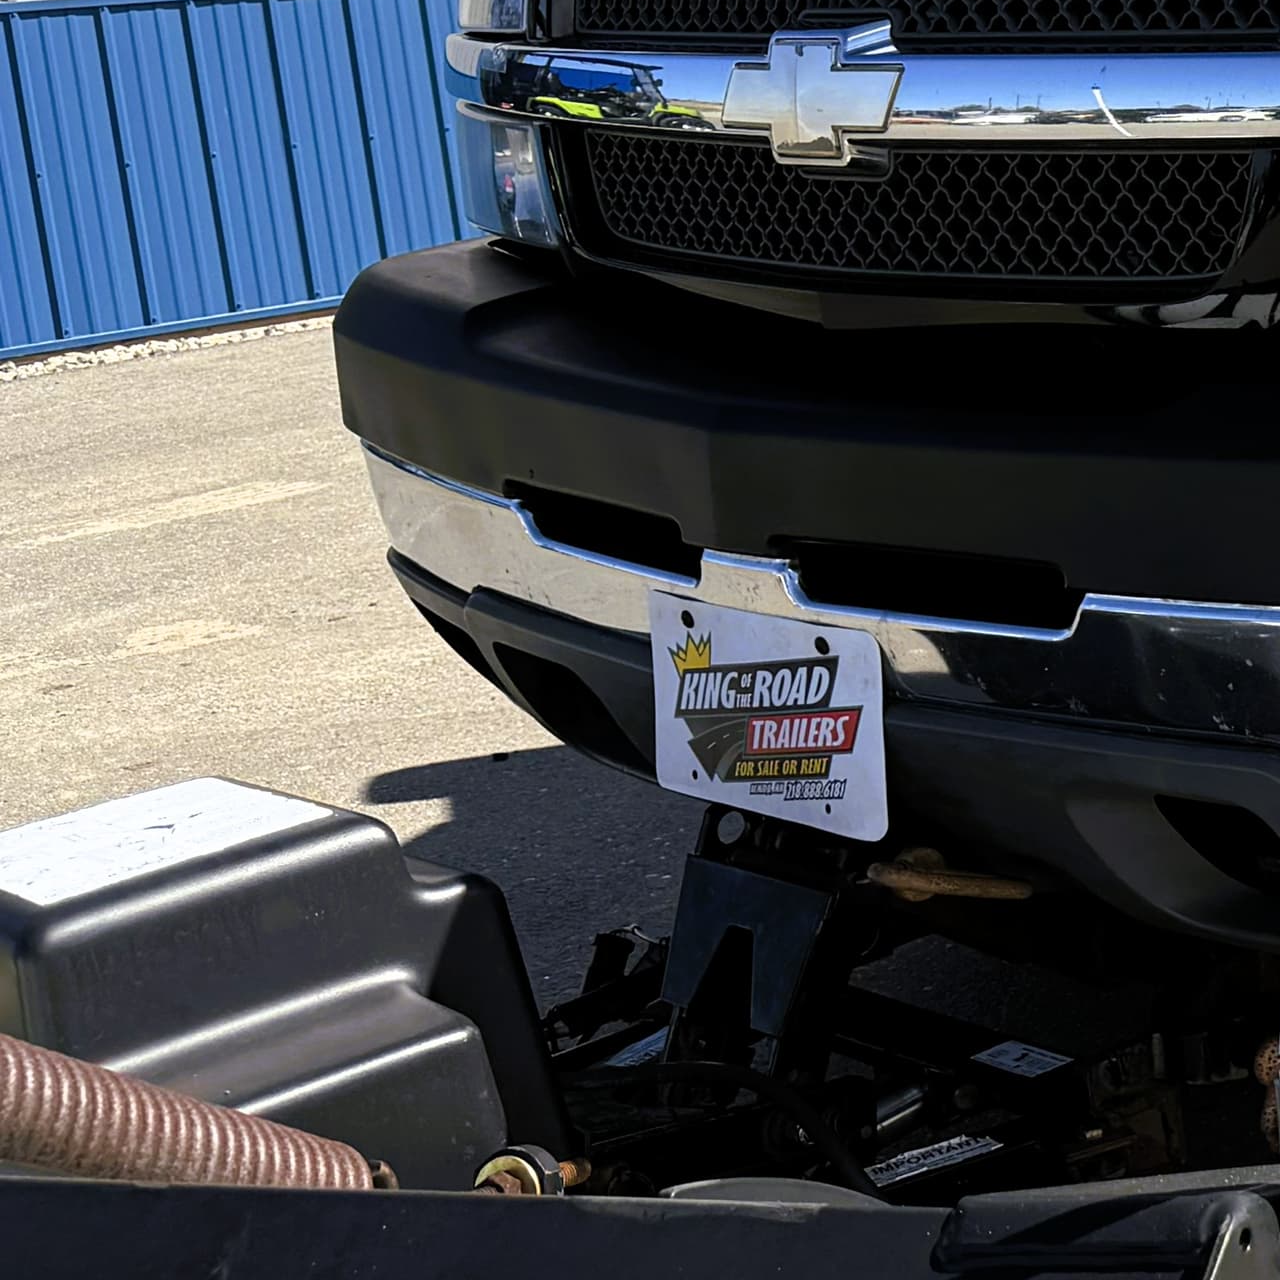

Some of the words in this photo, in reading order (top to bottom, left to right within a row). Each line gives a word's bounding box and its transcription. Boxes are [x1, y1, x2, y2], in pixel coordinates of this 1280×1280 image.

[681, 672, 738, 710] KING
[741, 673, 752, 687] OF
[753, 666, 830, 708] ROAD
[737, 693, 752, 708] THE
[752, 716, 849, 750] TRAILERS
[735, 761, 754, 777] FOR
[758, 759, 780, 776] SALE
[783, 759, 797, 775] OR
[801, 757, 829, 774] RENT
[872, 1137, 981, 1175] IMPORTANT
